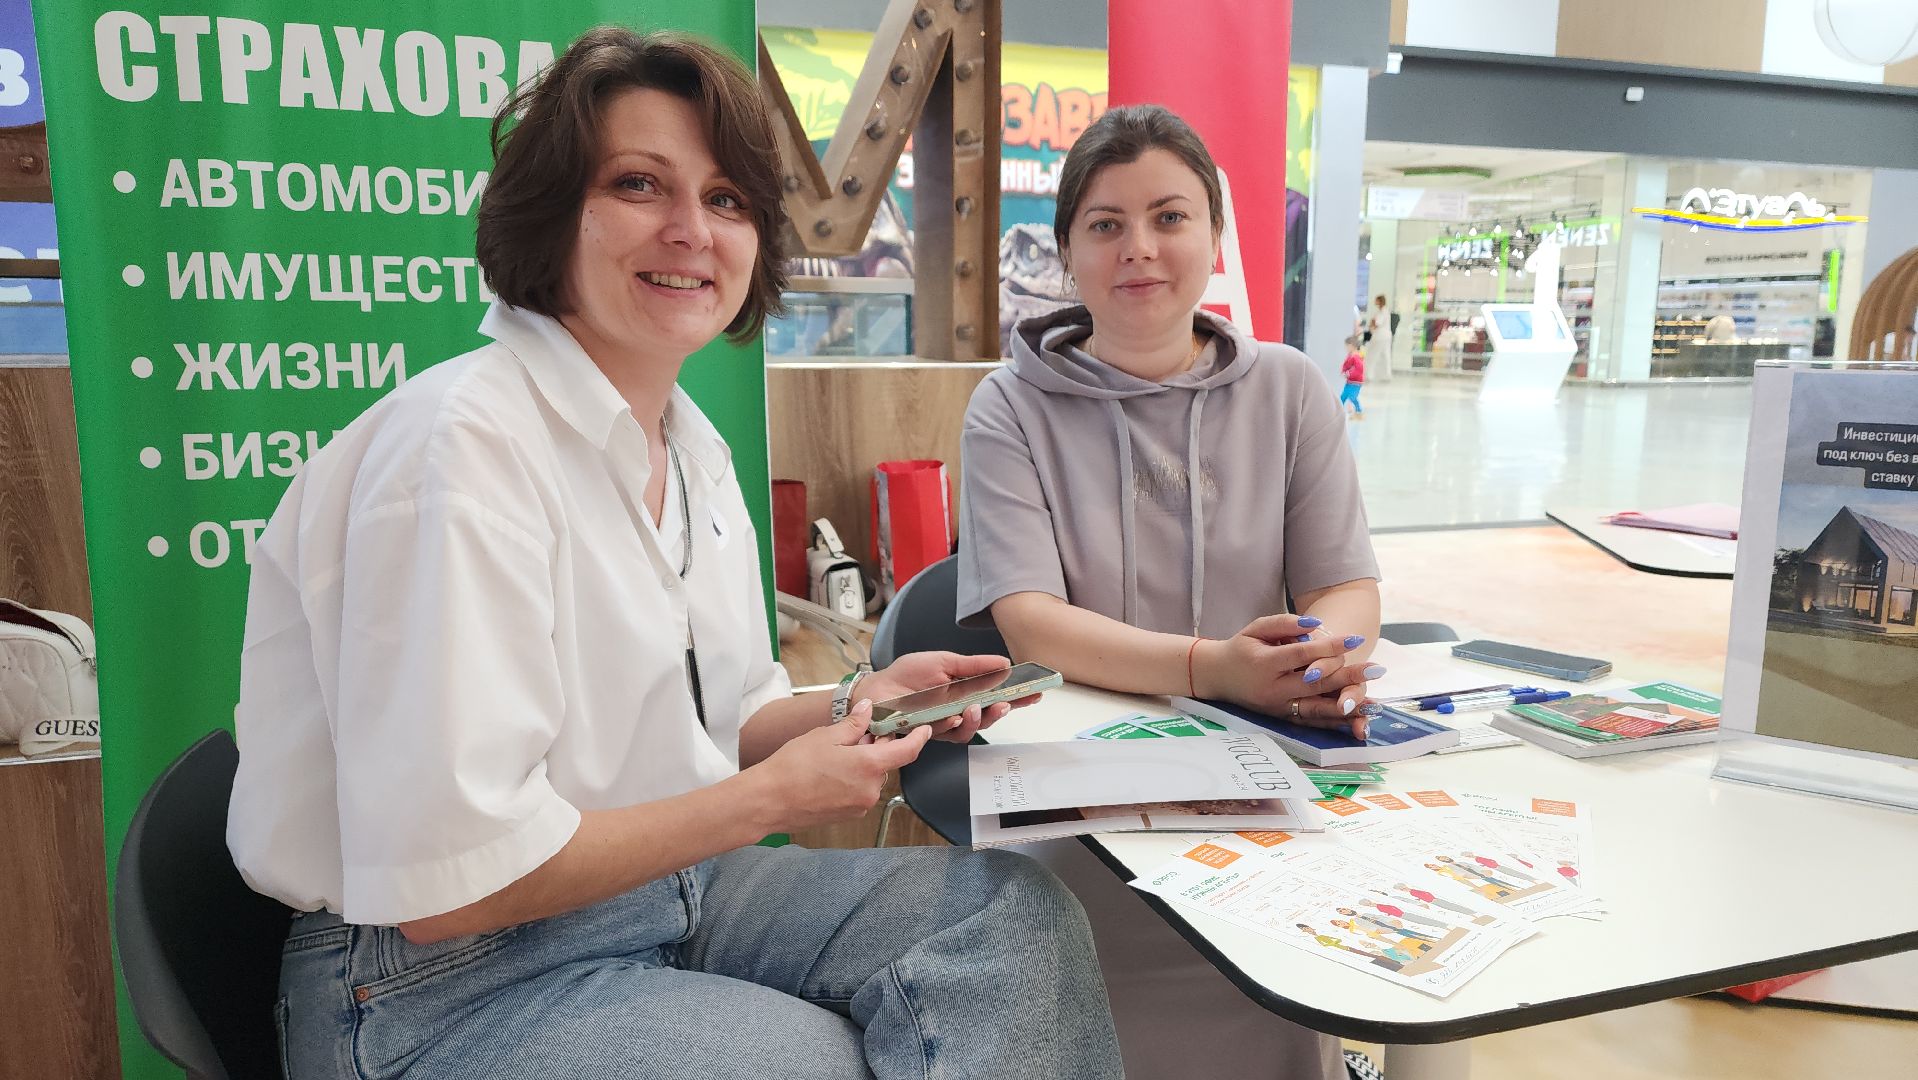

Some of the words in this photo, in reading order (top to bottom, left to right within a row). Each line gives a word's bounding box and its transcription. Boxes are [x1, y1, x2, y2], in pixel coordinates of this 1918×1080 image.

[173, 342, 407, 390] ЖИЗНИ
[1844, 426, 1918, 445] Инвестици
[1823, 449, 1848, 462] под
[1850, 450, 1884, 462] ключ
[1886, 450, 1910, 464] без
[1871, 472, 1915, 488] ставку
[36, 720, 100, 737] GUES
